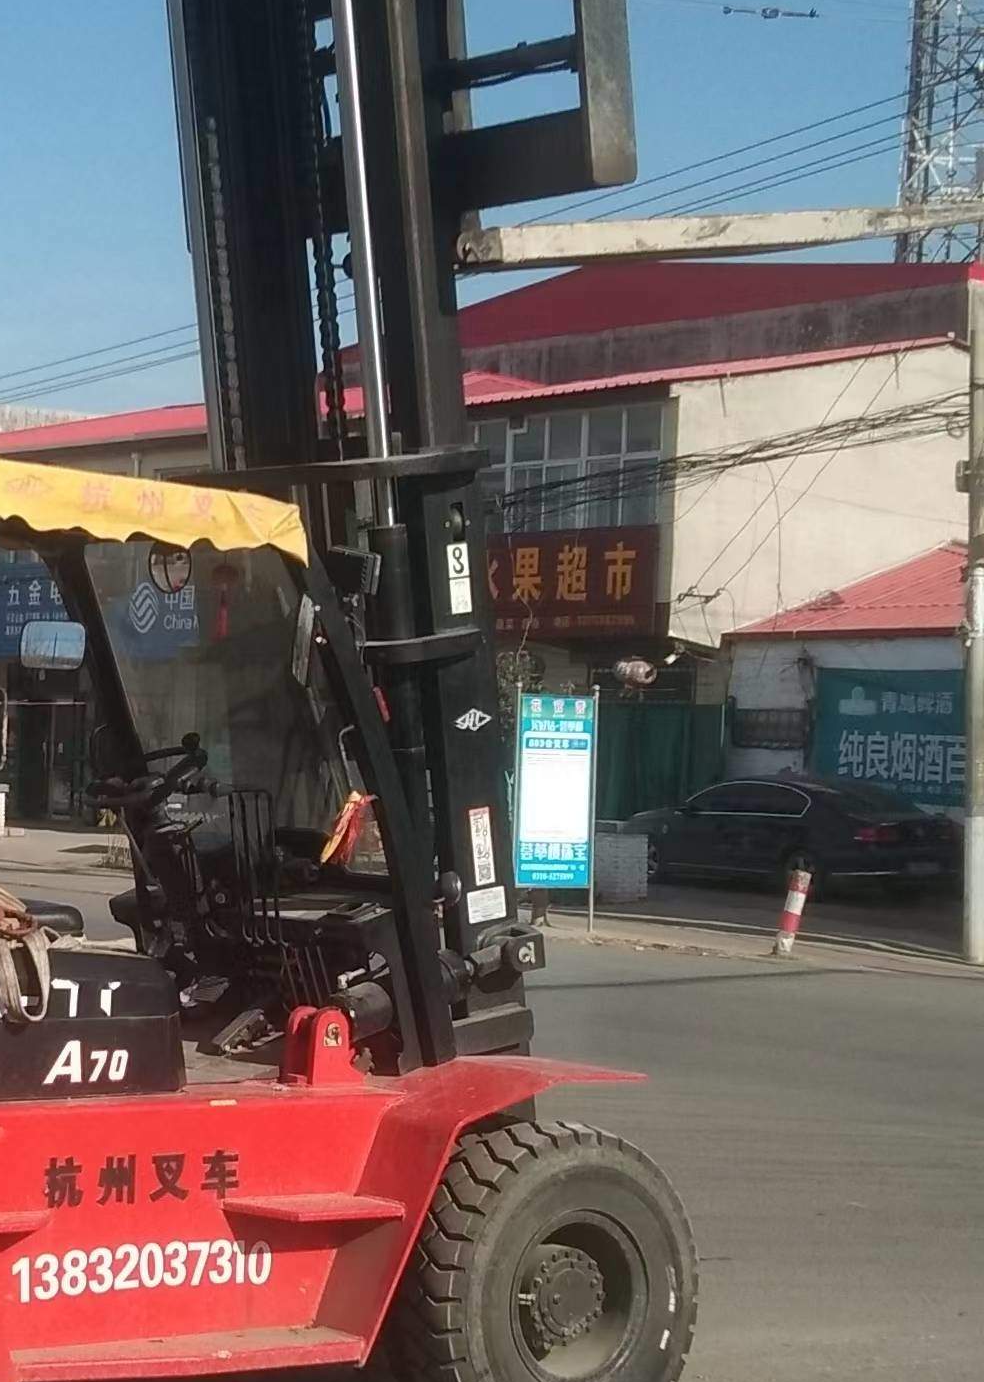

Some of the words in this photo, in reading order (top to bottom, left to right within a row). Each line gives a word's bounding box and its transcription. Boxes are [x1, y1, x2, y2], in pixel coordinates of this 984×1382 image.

[165, 584, 195, 610] 中国
[163, 615, 193, 630] China
[43, 1149, 240, 1208] 杭州叉车
[11, 1238, 273, 1304] 13832037310
